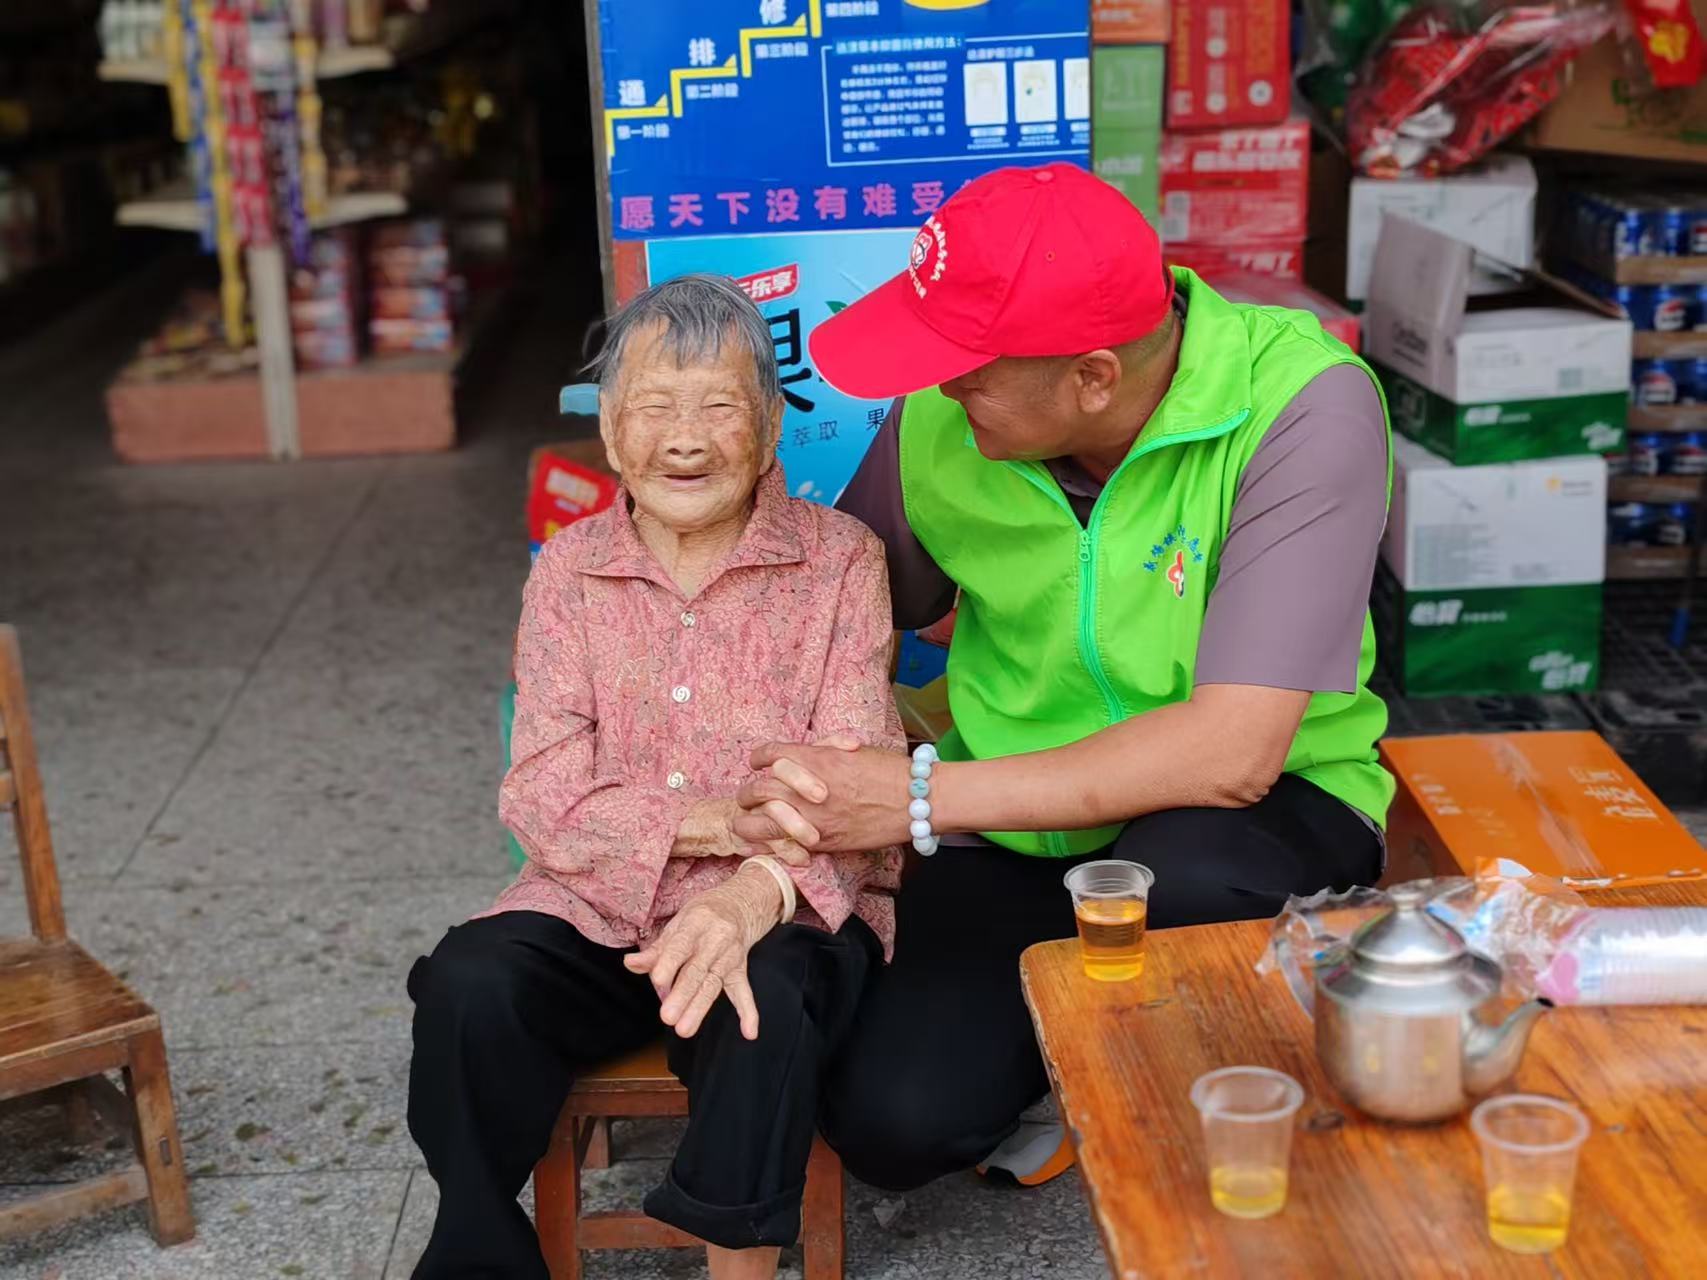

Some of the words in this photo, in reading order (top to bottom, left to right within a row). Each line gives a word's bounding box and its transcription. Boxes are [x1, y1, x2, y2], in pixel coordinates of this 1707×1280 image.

[758, 0, 787, 25] 修
[688, 37, 717, 66] 排
[755, 42, 809, 59] 第三阶段
[618, 79, 647, 106] 通
[685, 82, 739, 100] 第二阶段
[616, 123, 670, 140] 第一阶段
[620, 180, 968, 230] 愿天下没有难受
